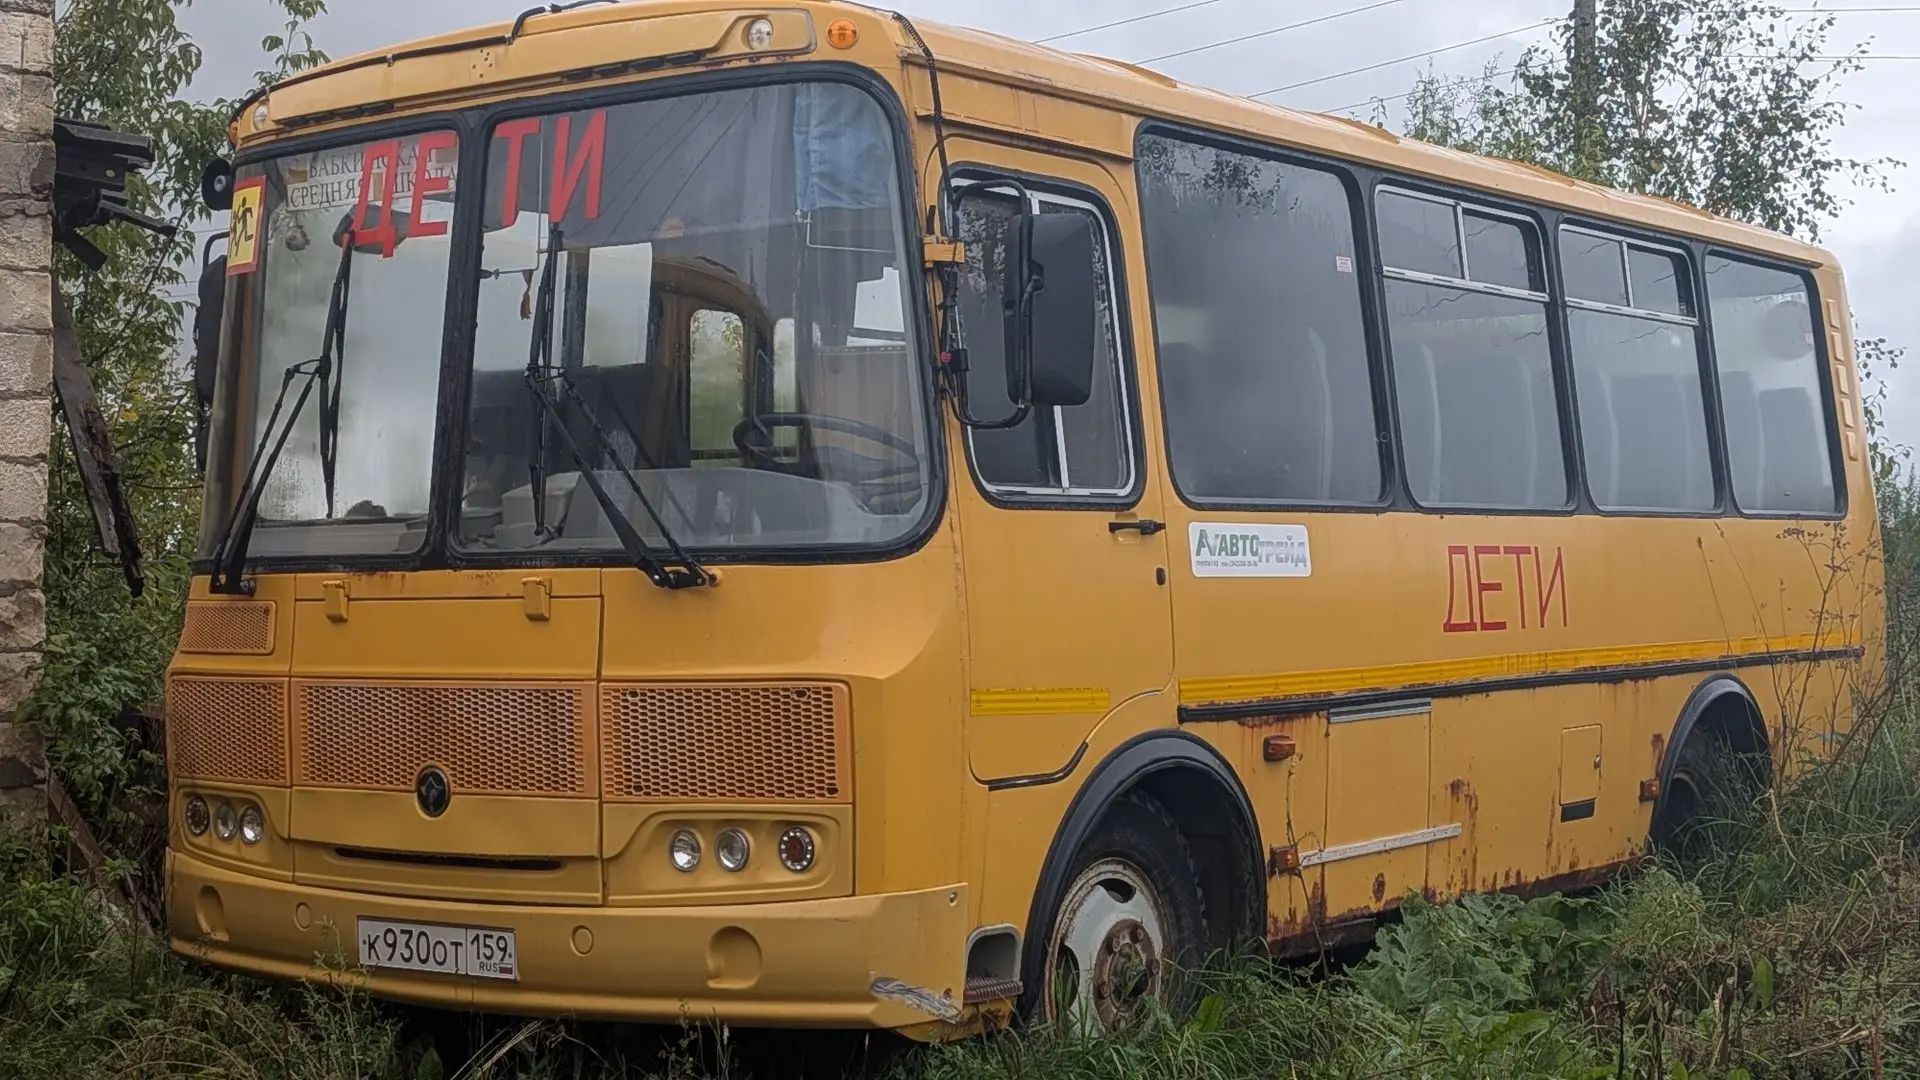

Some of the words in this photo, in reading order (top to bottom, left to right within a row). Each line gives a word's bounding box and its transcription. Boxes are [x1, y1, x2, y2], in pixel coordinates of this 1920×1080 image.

[290, 177, 364, 208] СРЕДНЯ
[351, 110, 608, 258] ДЕТИ
[1443, 545, 1568, 632] ДЕТИ
[471, 933, 508, 962] 159
[478, 961, 499, 973] RUS
